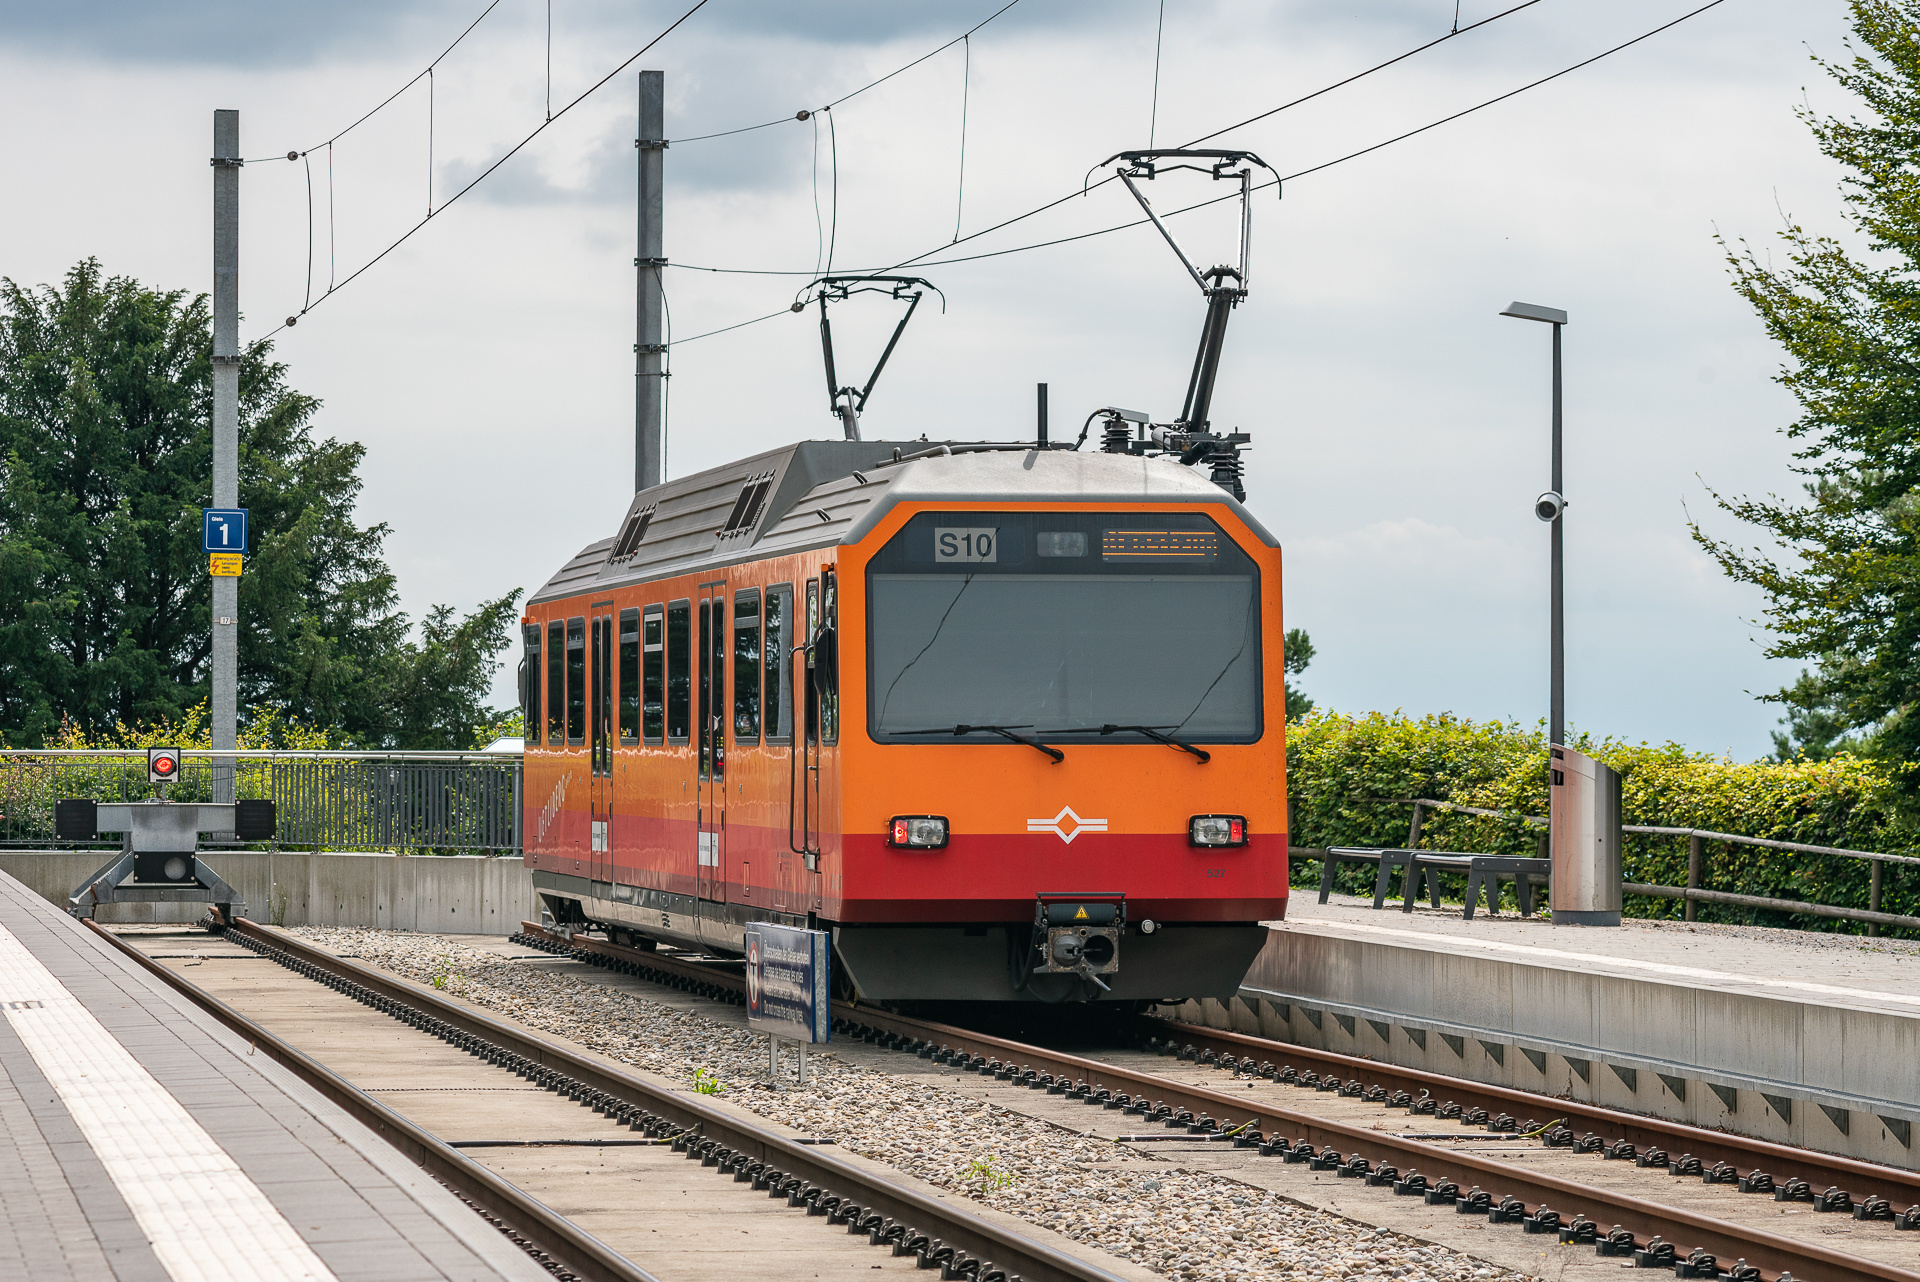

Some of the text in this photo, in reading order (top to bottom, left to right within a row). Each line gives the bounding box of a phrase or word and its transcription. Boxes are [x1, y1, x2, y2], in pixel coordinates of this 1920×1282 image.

[220, 524, 228, 546] 1
[938, 532, 993, 557] S10
[1206, 868, 1226, 878] 527
